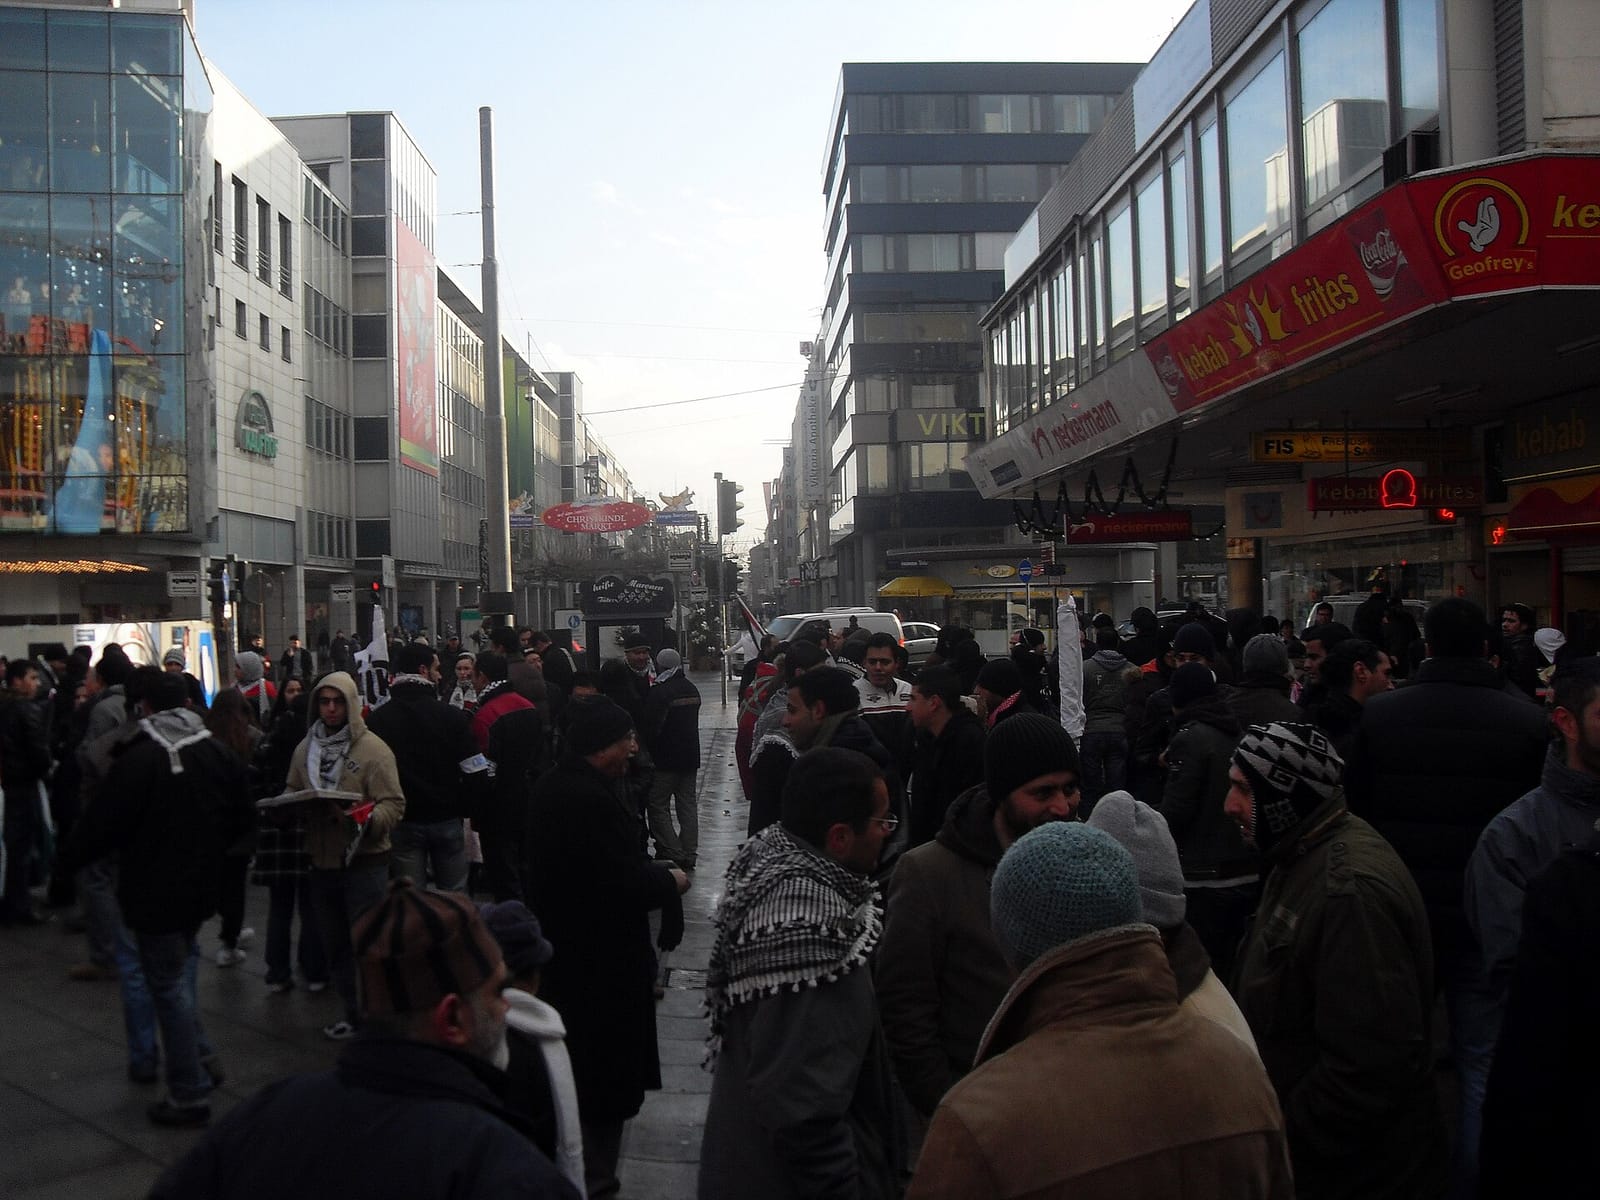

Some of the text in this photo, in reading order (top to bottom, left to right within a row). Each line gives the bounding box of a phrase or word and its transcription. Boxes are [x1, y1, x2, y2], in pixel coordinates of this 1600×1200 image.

[1177, 272, 1361, 381] kebab frites
[917, 413, 985, 435] VIKT
[1051, 399, 1121, 450] neckermann
[1514, 408, 1585, 460] kebab
[1264, 439, 1295, 456] FIS
[1318, 481, 1475, 500] kebab frites
[1103, 519, 1189, 534] neckermann
